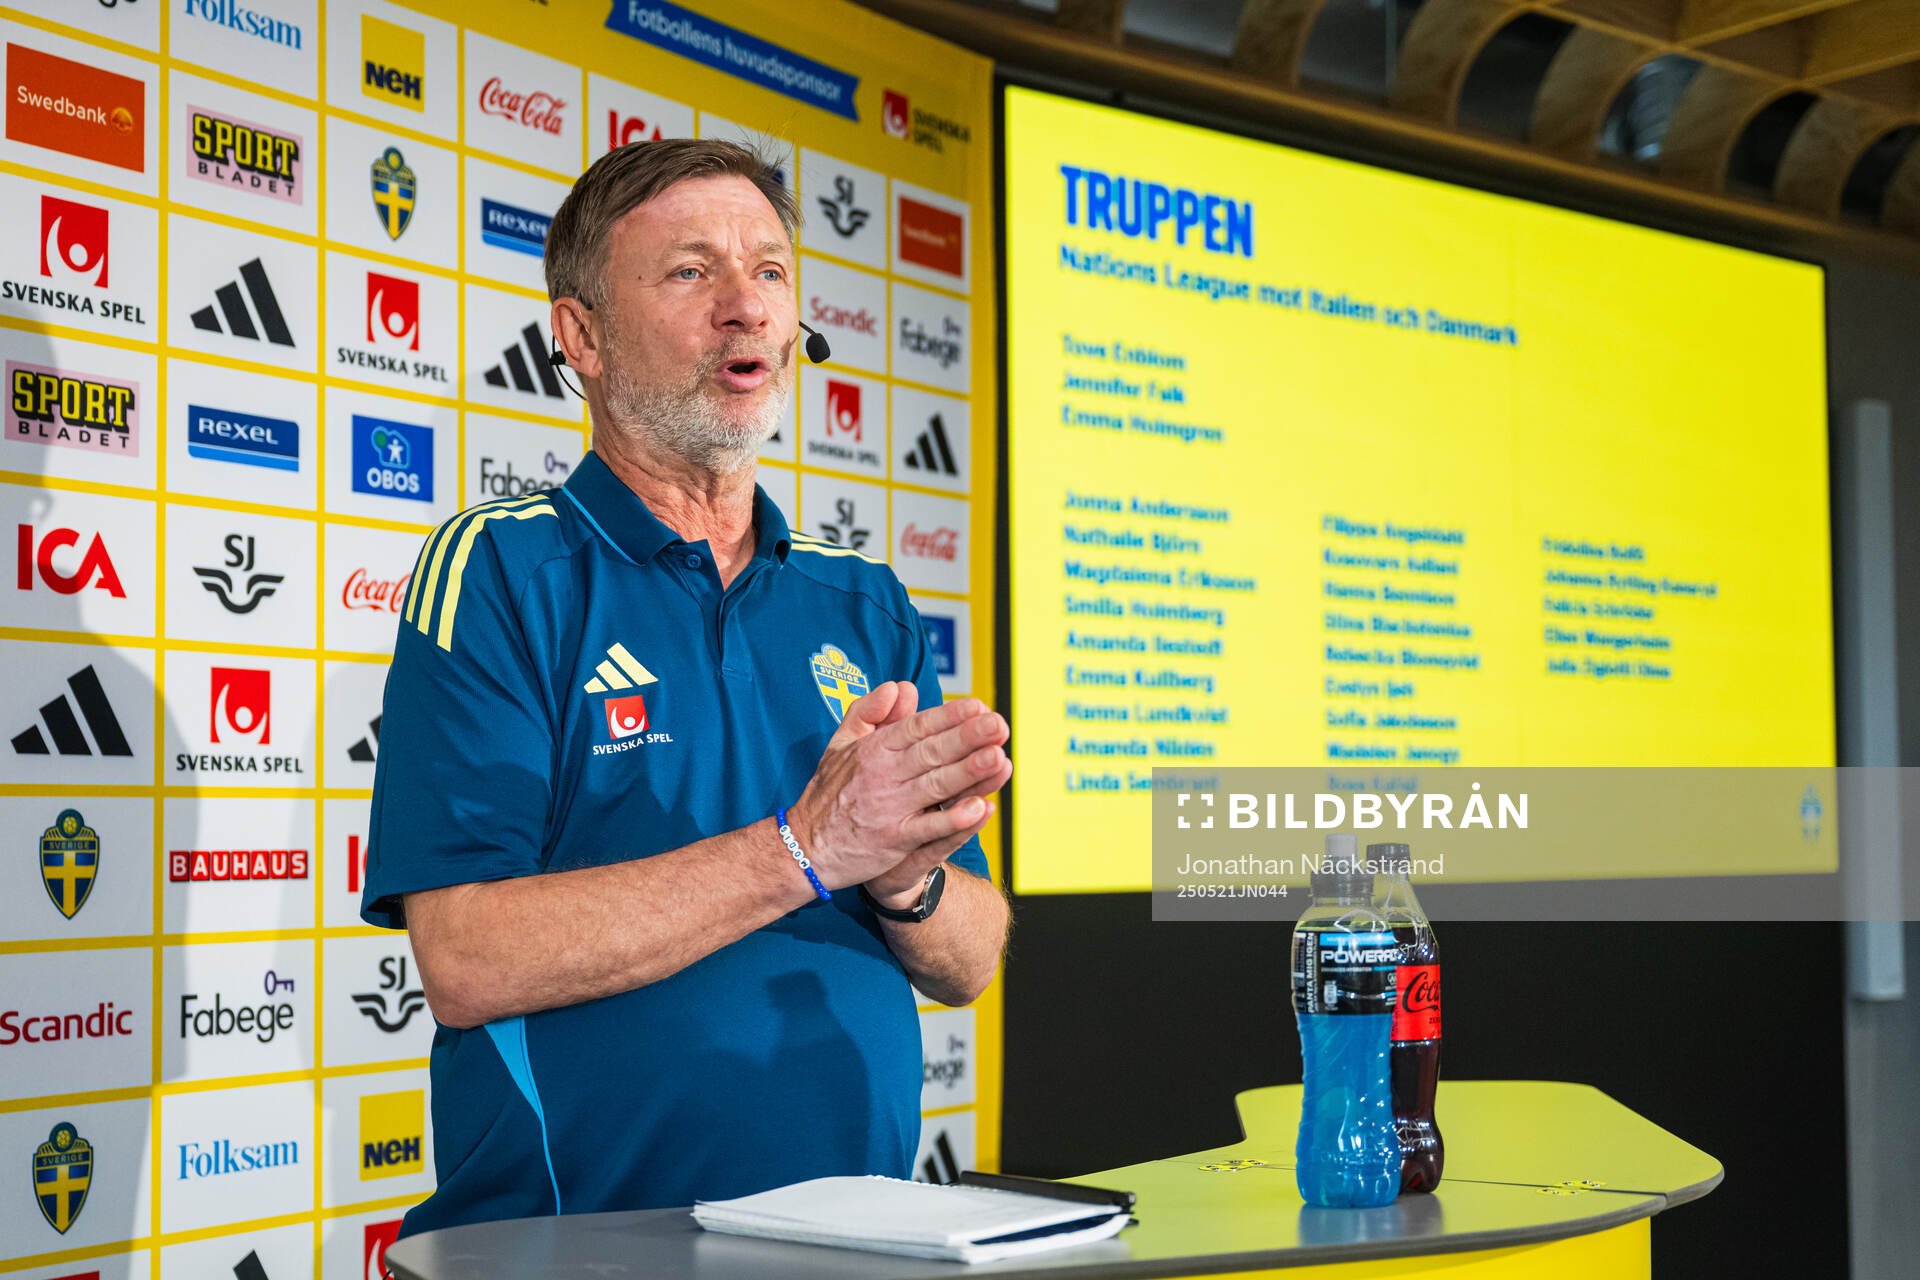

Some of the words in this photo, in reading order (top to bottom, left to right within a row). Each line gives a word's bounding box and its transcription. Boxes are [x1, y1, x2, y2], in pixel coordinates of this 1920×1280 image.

[627, 0, 722, 60] Fotbollens
[17, 86, 107, 126] Swedbank
[479, 76, 567, 136] Coca-Cola
[193, 113, 300, 181] SPORT
[198, 162, 295, 197] BLADET
[1059, 163, 1254, 259] TRUPPEN
[1059, 243, 1158, 284] Nations
[1163, 263, 1250, 301] League
[1257, 282, 1303, 309] mot
[2, 280, 94, 314] SVENSKA
[100, 299, 147, 325] SPEL
[337, 346, 408, 374] SVENSKA
[413, 360, 448, 383] SPEL
[12, 369, 135, 433] SPORT
[18, 420, 130, 449] BLADET
[366, 466, 420, 495] OBOS
[17, 523, 127, 599] ICA
[224, 533, 256, 573] SJ
[820, 666, 860, 684] SVERIGE
[176, 753, 258, 772] SVENSKA
[263, 756, 304, 774] SPEL
[592, 737, 645, 756] SVENSKA
[646, 732, 674, 745] SPEL
[48, 839, 92, 851] SVERIGE
[171, 850, 308, 882] BAUHAUS
[379, 956, 406, 992] SJ
[0, 1001, 133, 1045] Scandic
[180, 993, 295, 1044] Fabege
[177, 1138, 299, 1180] Folksam
